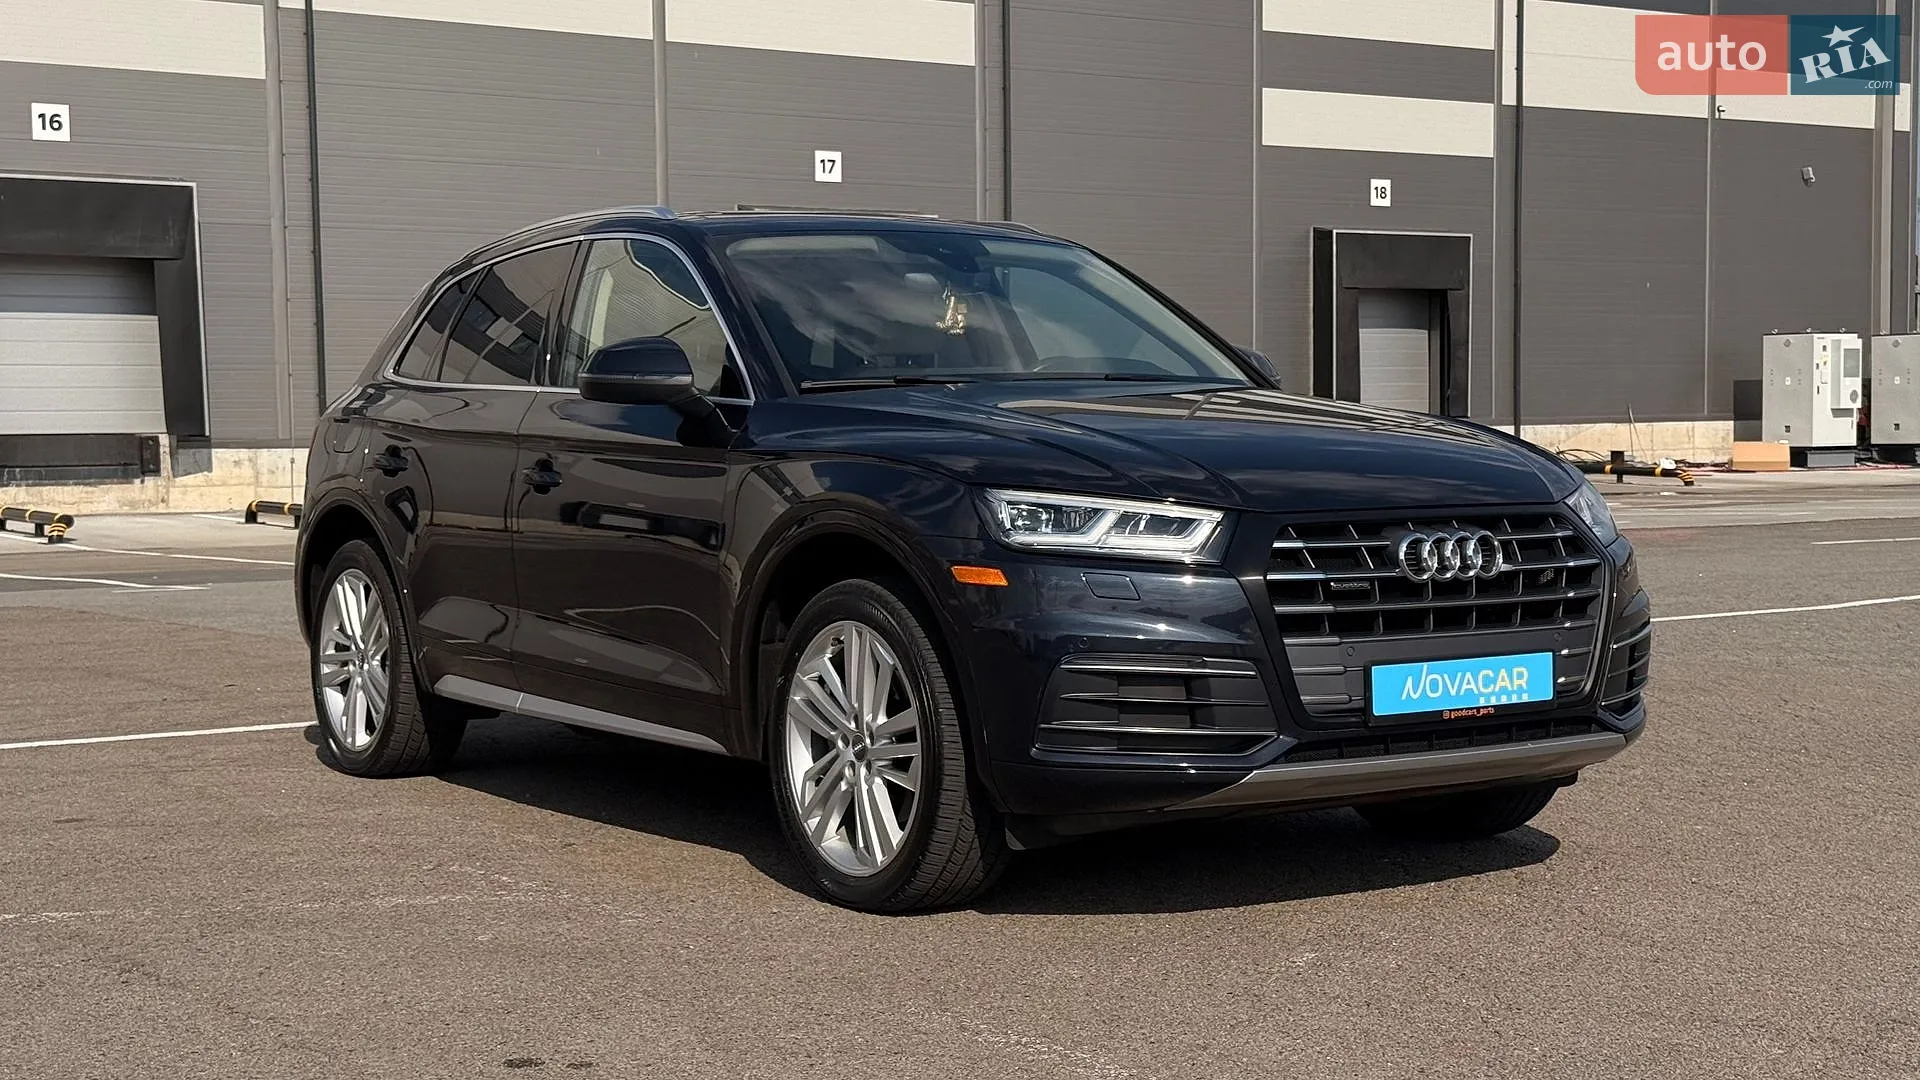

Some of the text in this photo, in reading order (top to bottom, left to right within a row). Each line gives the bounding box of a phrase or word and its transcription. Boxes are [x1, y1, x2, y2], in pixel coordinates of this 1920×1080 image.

[38, 113, 63, 131] 16
[820, 159, 836, 174] 17
[1374, 186, 1387, 199] 18
